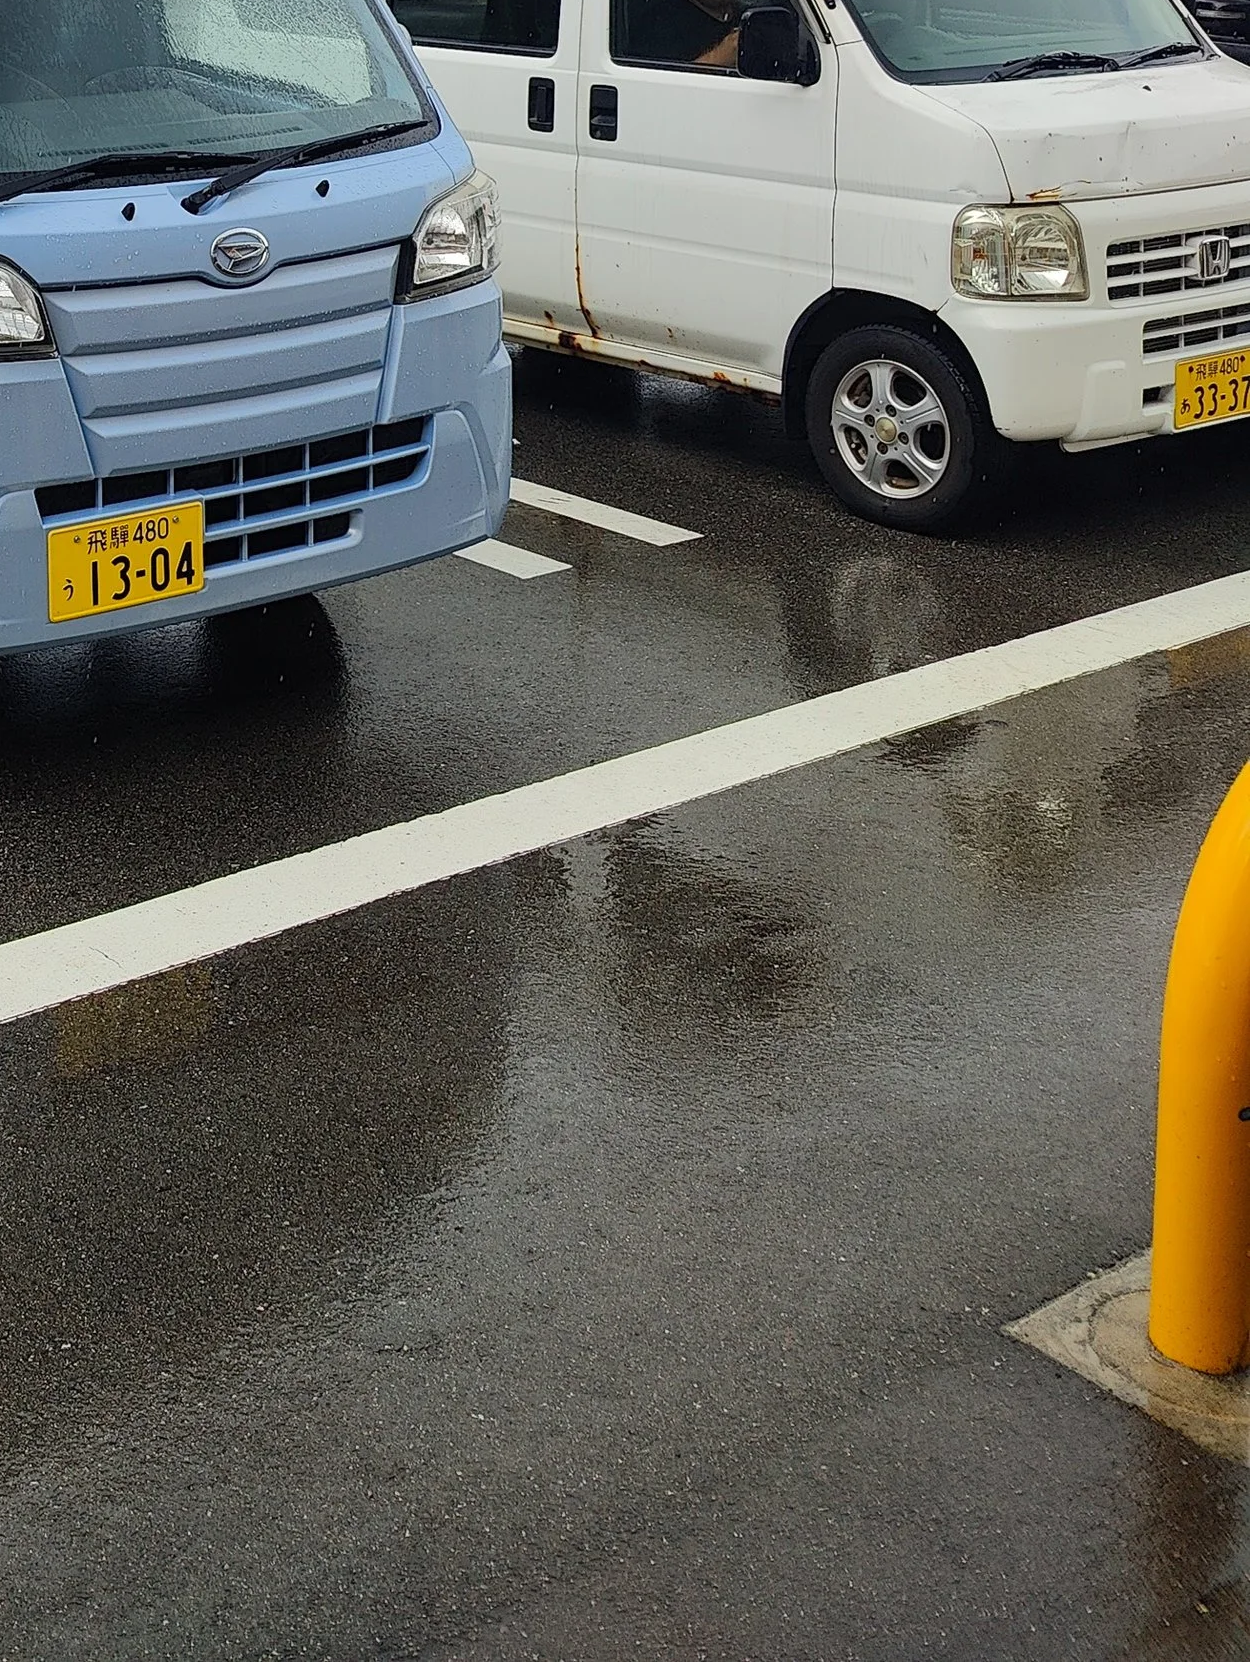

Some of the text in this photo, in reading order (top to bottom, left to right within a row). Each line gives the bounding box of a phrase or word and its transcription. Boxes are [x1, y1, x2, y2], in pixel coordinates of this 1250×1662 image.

[1220, 356, 1240, 375] 480
[1180, 375, 1250, 419] あ 33-37
[133, 516, 170, 544] 480
[62, 541, 196, 607] う 13-04
